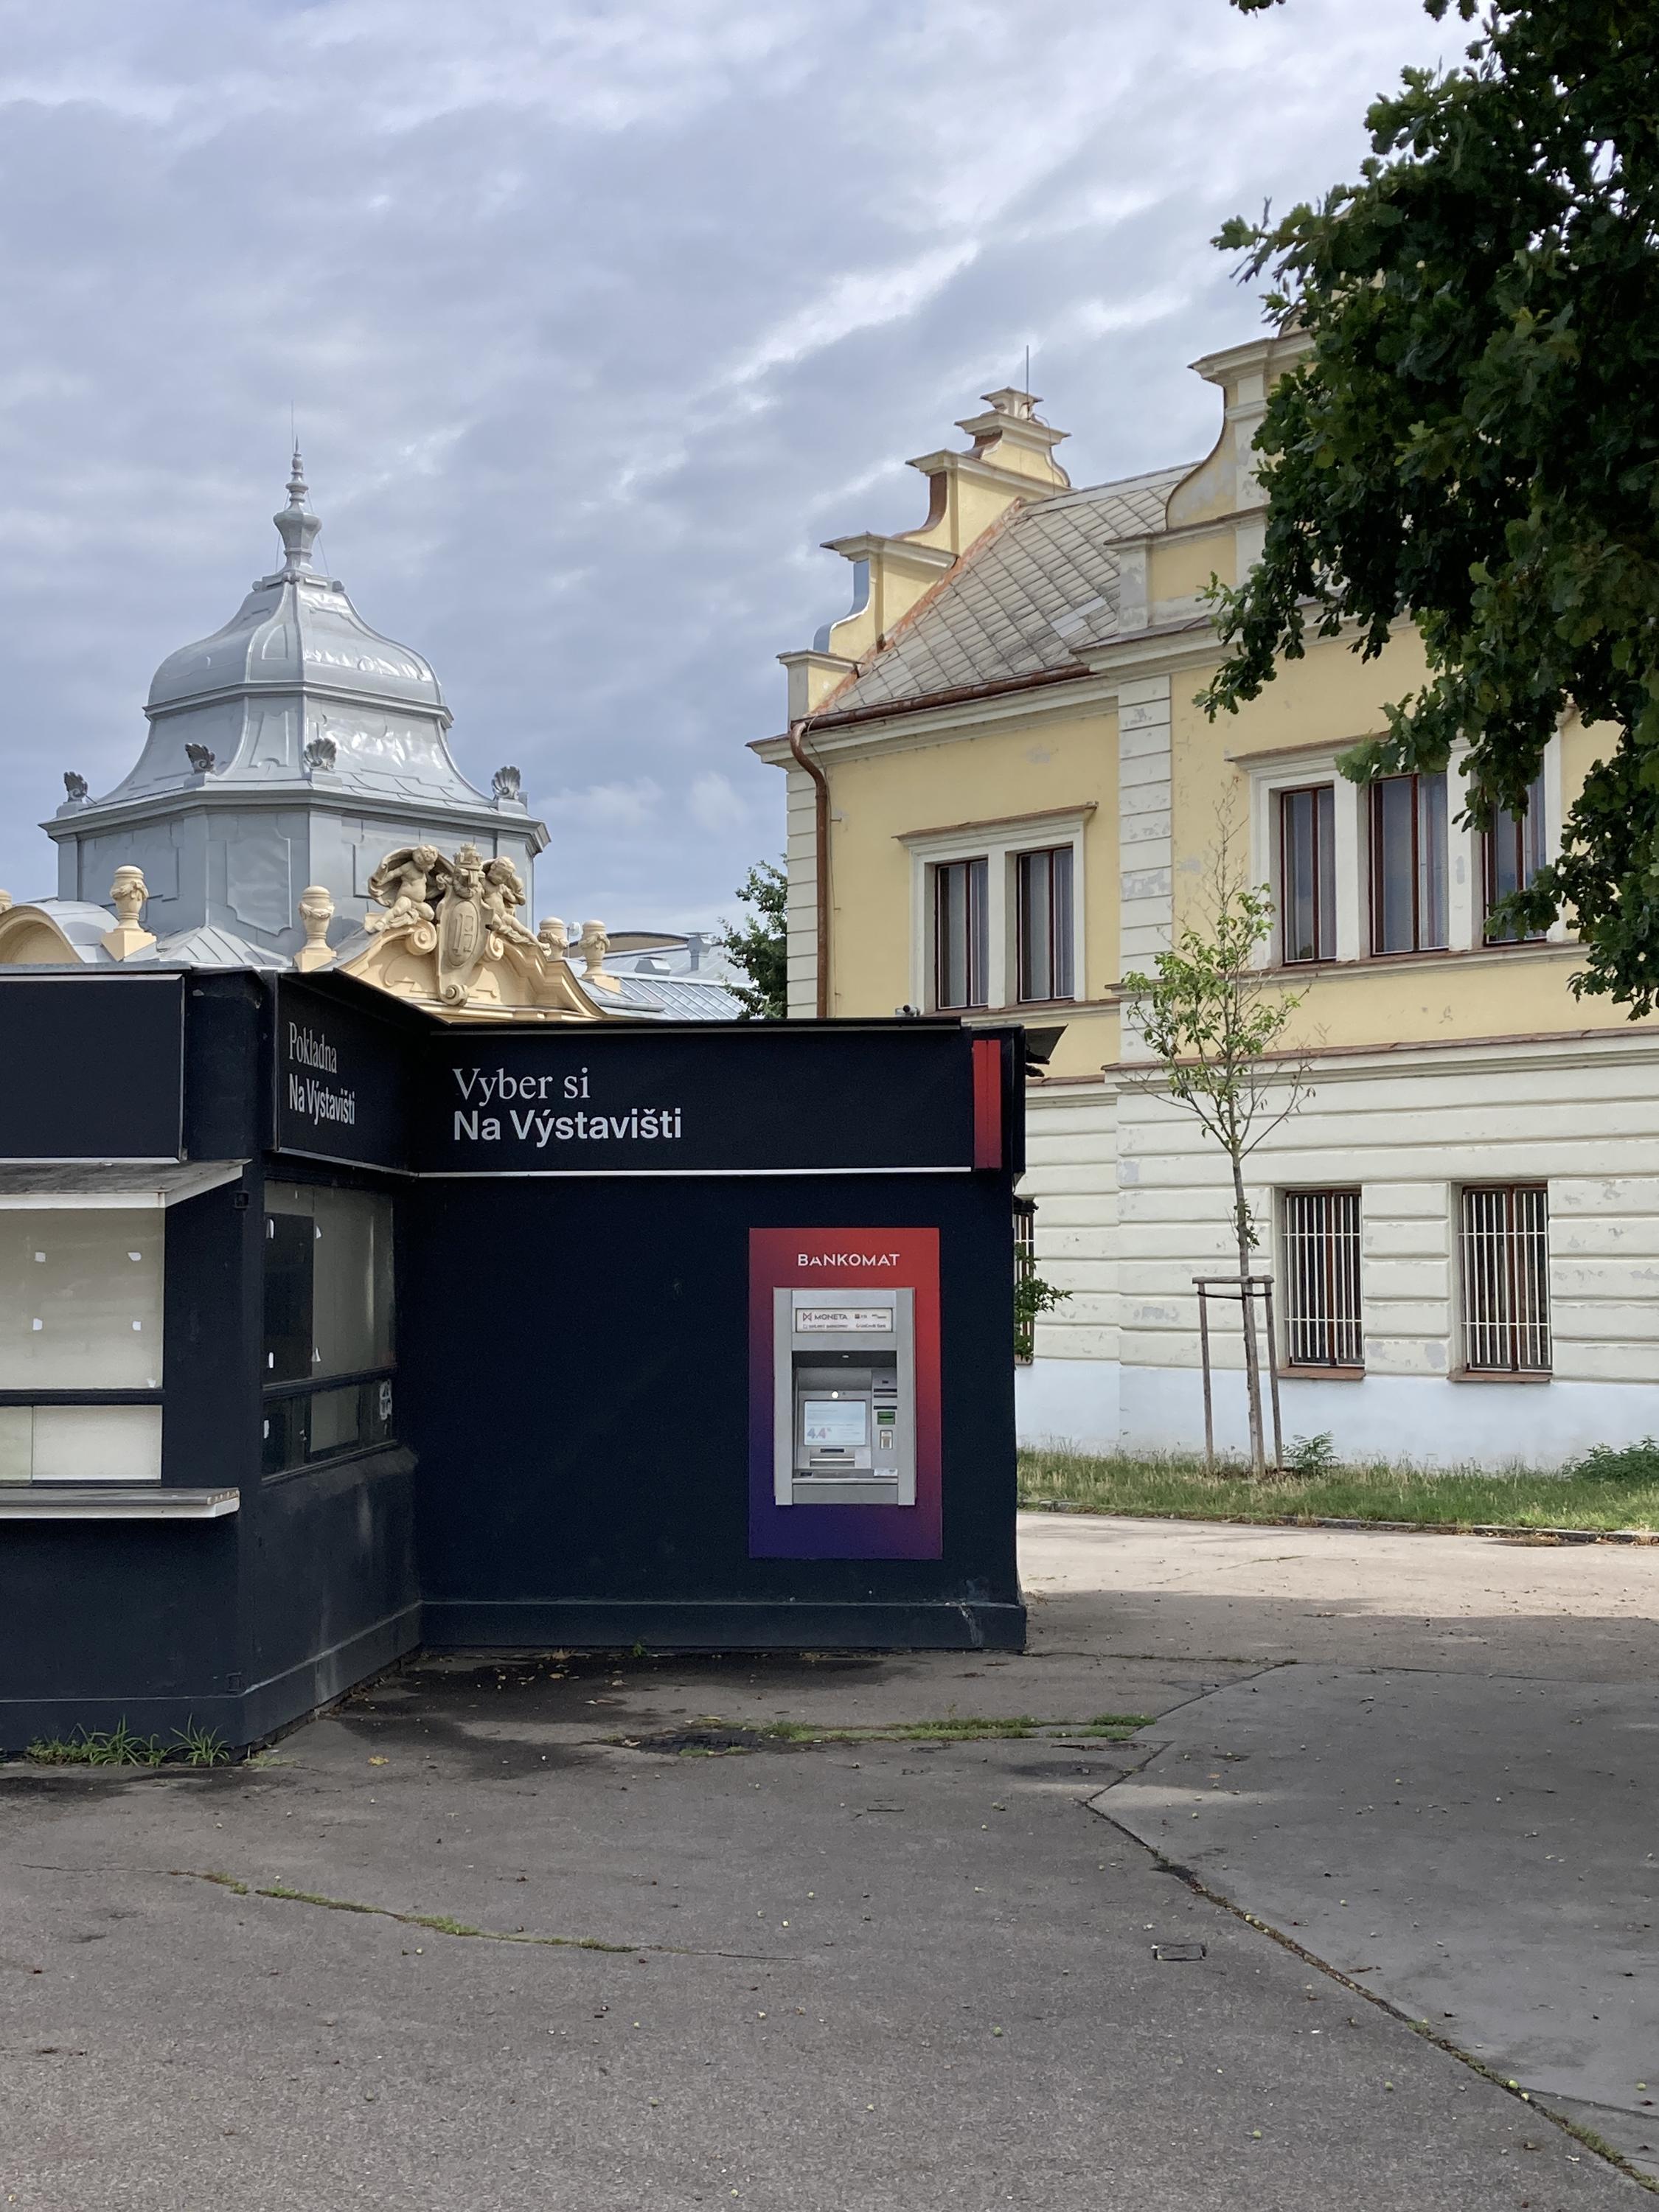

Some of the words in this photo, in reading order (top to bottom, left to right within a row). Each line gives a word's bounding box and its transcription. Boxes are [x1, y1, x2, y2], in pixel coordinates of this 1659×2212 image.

[288, 1021, 337, 1074] Pokladna
[289, 1073, 305, 1112] Na
[306, 1078, 355, 1125] Výstavišti
[452, 1068, 553, 1107] Vyber
[564, 1067, 591, 1099] si
[454, 1110, 501, 1140] Na
[509, 1107, 681, 1147] Výstavišti
[797, 1253, 900, 1266] BANKOMAT
